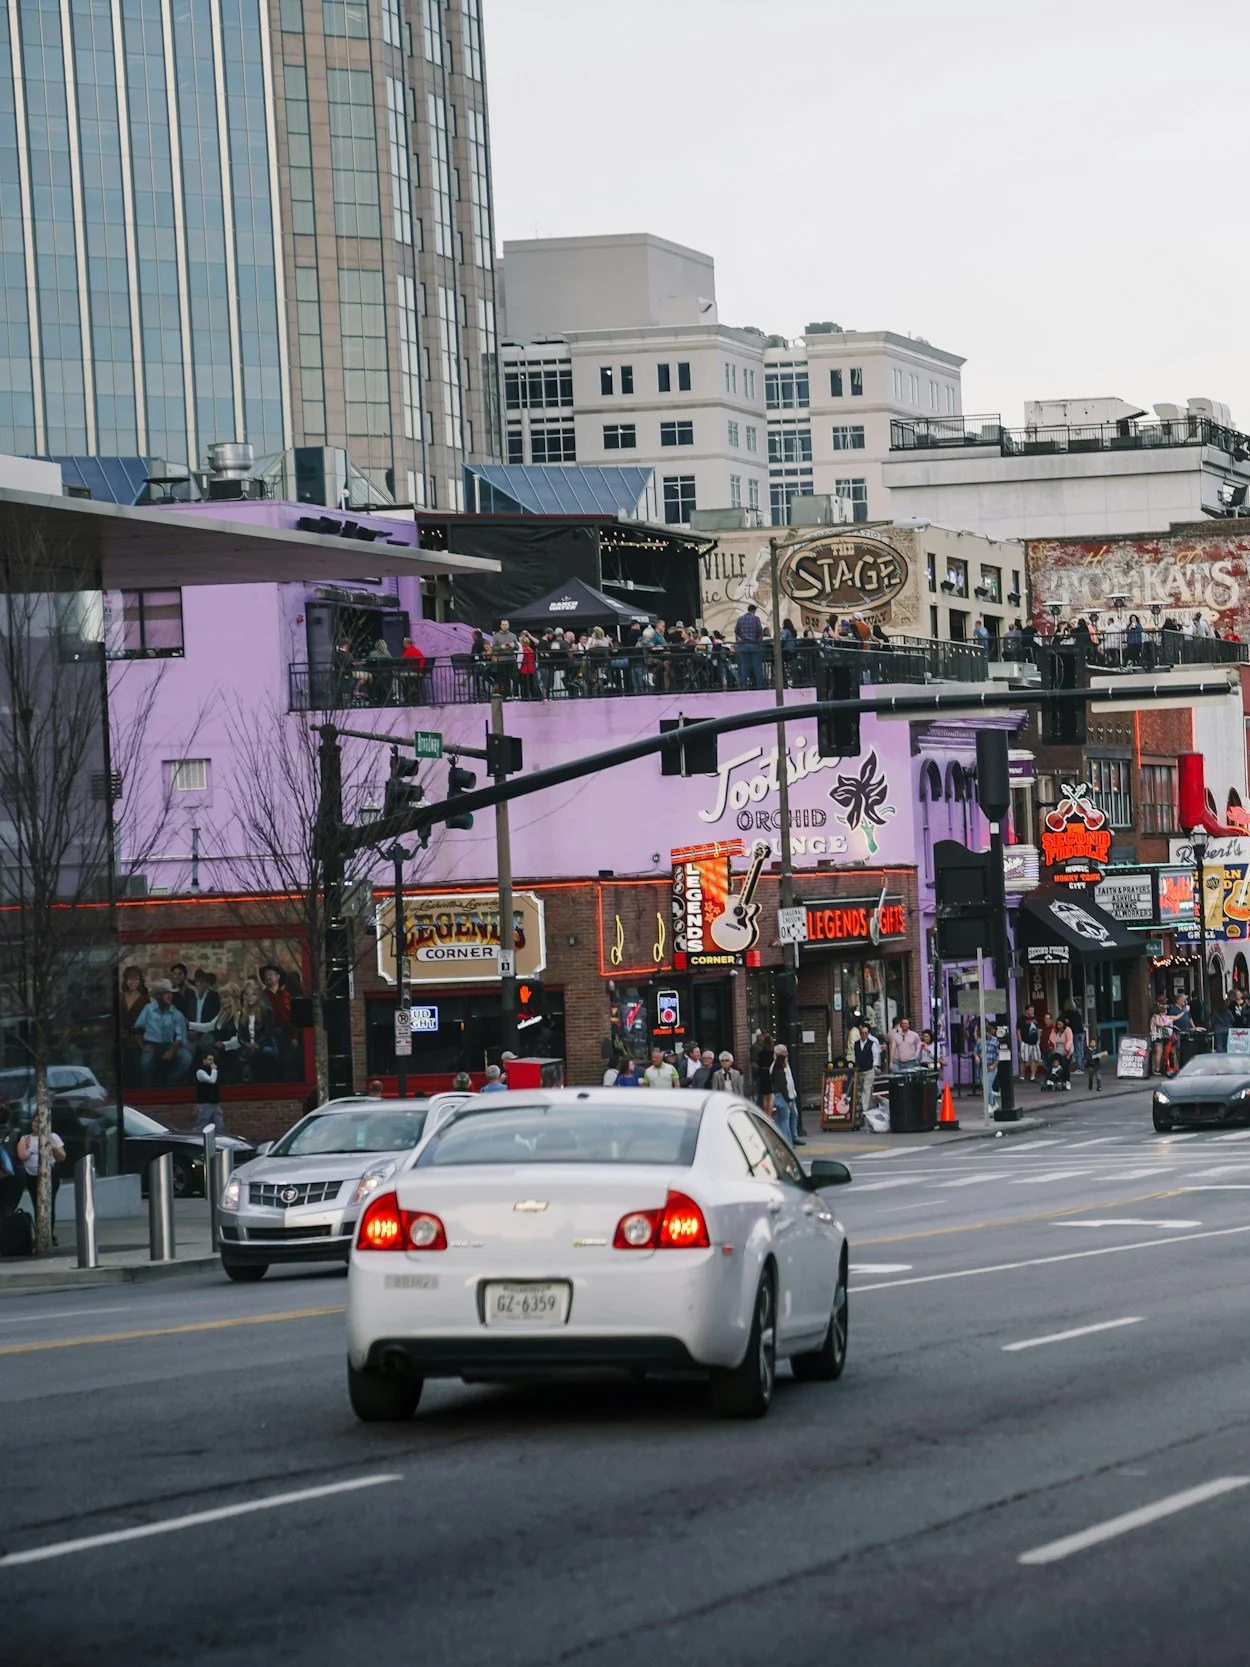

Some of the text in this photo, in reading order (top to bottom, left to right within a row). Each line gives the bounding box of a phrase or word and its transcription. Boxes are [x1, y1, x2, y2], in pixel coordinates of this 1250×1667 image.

[830, 543, 855, 556] THE
[702, 552, 747, 580] VILLE
[789, 551, 901, 598] STAGE
[417, 732, 441, 755] Broadway
[736, 808, 827, 832] ORCHID
[1042, 831, 1111, 847] SECOND
[743, 835, 848, 857] OUNGE
[1176, 838, 1242, 863] Rbert's
[1045, 845, 1108, 866] FIDDLE
[1065, 865, 1089, 873] MUSIC
[1054, 874, 1079, 882] HONKY
[1098, 886, 1117, 894] FAITH
[1122, 885, 1151, 894] PRAYERS
[686, 863, 704, 953] LEGENDS
[1112, 902, 1138, 910] THANKS
[878, 905, 906, 934] GIFTS
[1123, 909, 1152, 918] WORKERS
[807, 909, 867, 940] LEGENDS
[781, 926, 792, 938] OK
[1188, 931, 1216, 939] GRLL
[426, 947, 493, 959] CORNER
[1028, 946, 1070, 959] SECOND FIDDLE
[690, 955, 735, 965] CORNER
[1032, 991, 1045, 1000] BAR
[411, 1009, 431, 1018] UD
